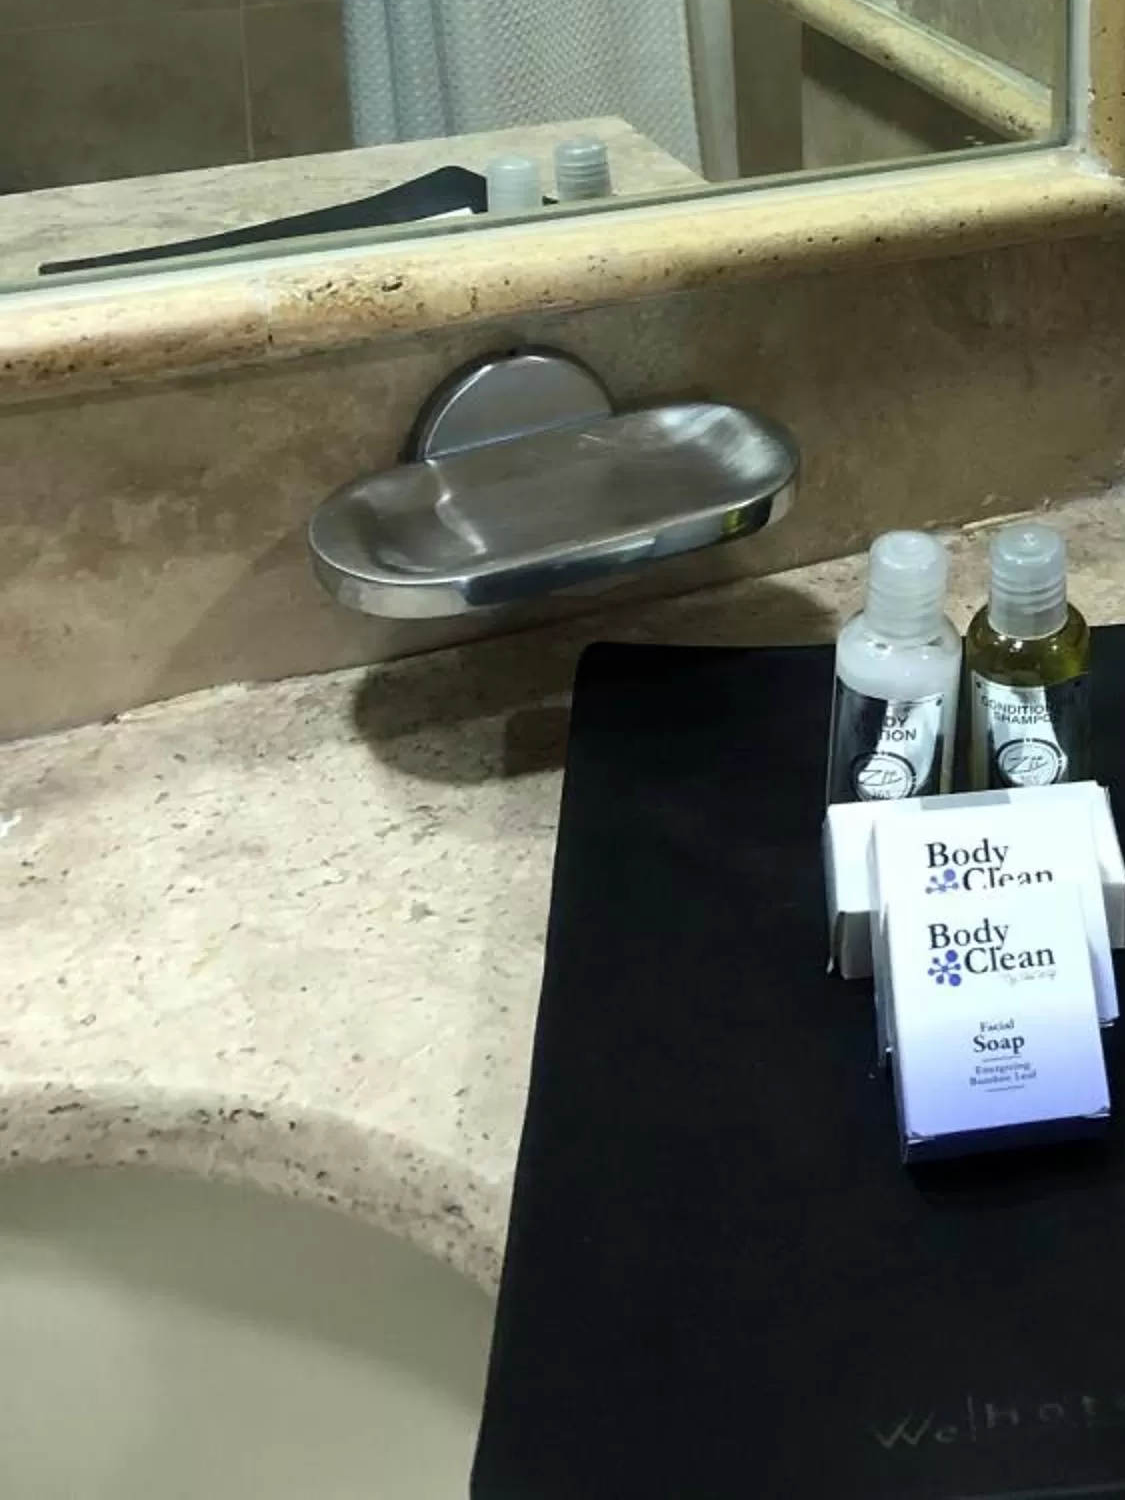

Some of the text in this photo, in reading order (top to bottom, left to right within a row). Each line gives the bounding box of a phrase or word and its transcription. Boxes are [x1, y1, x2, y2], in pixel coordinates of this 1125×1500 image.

[925, 838, 1009, 871] Body
[928, 918, 1009, 951] Body
[964, 946, 1056, 974] Clean
[980, 1018, 1015, 1033] Facial
[972, 1034, 1025, 1054] Soap
